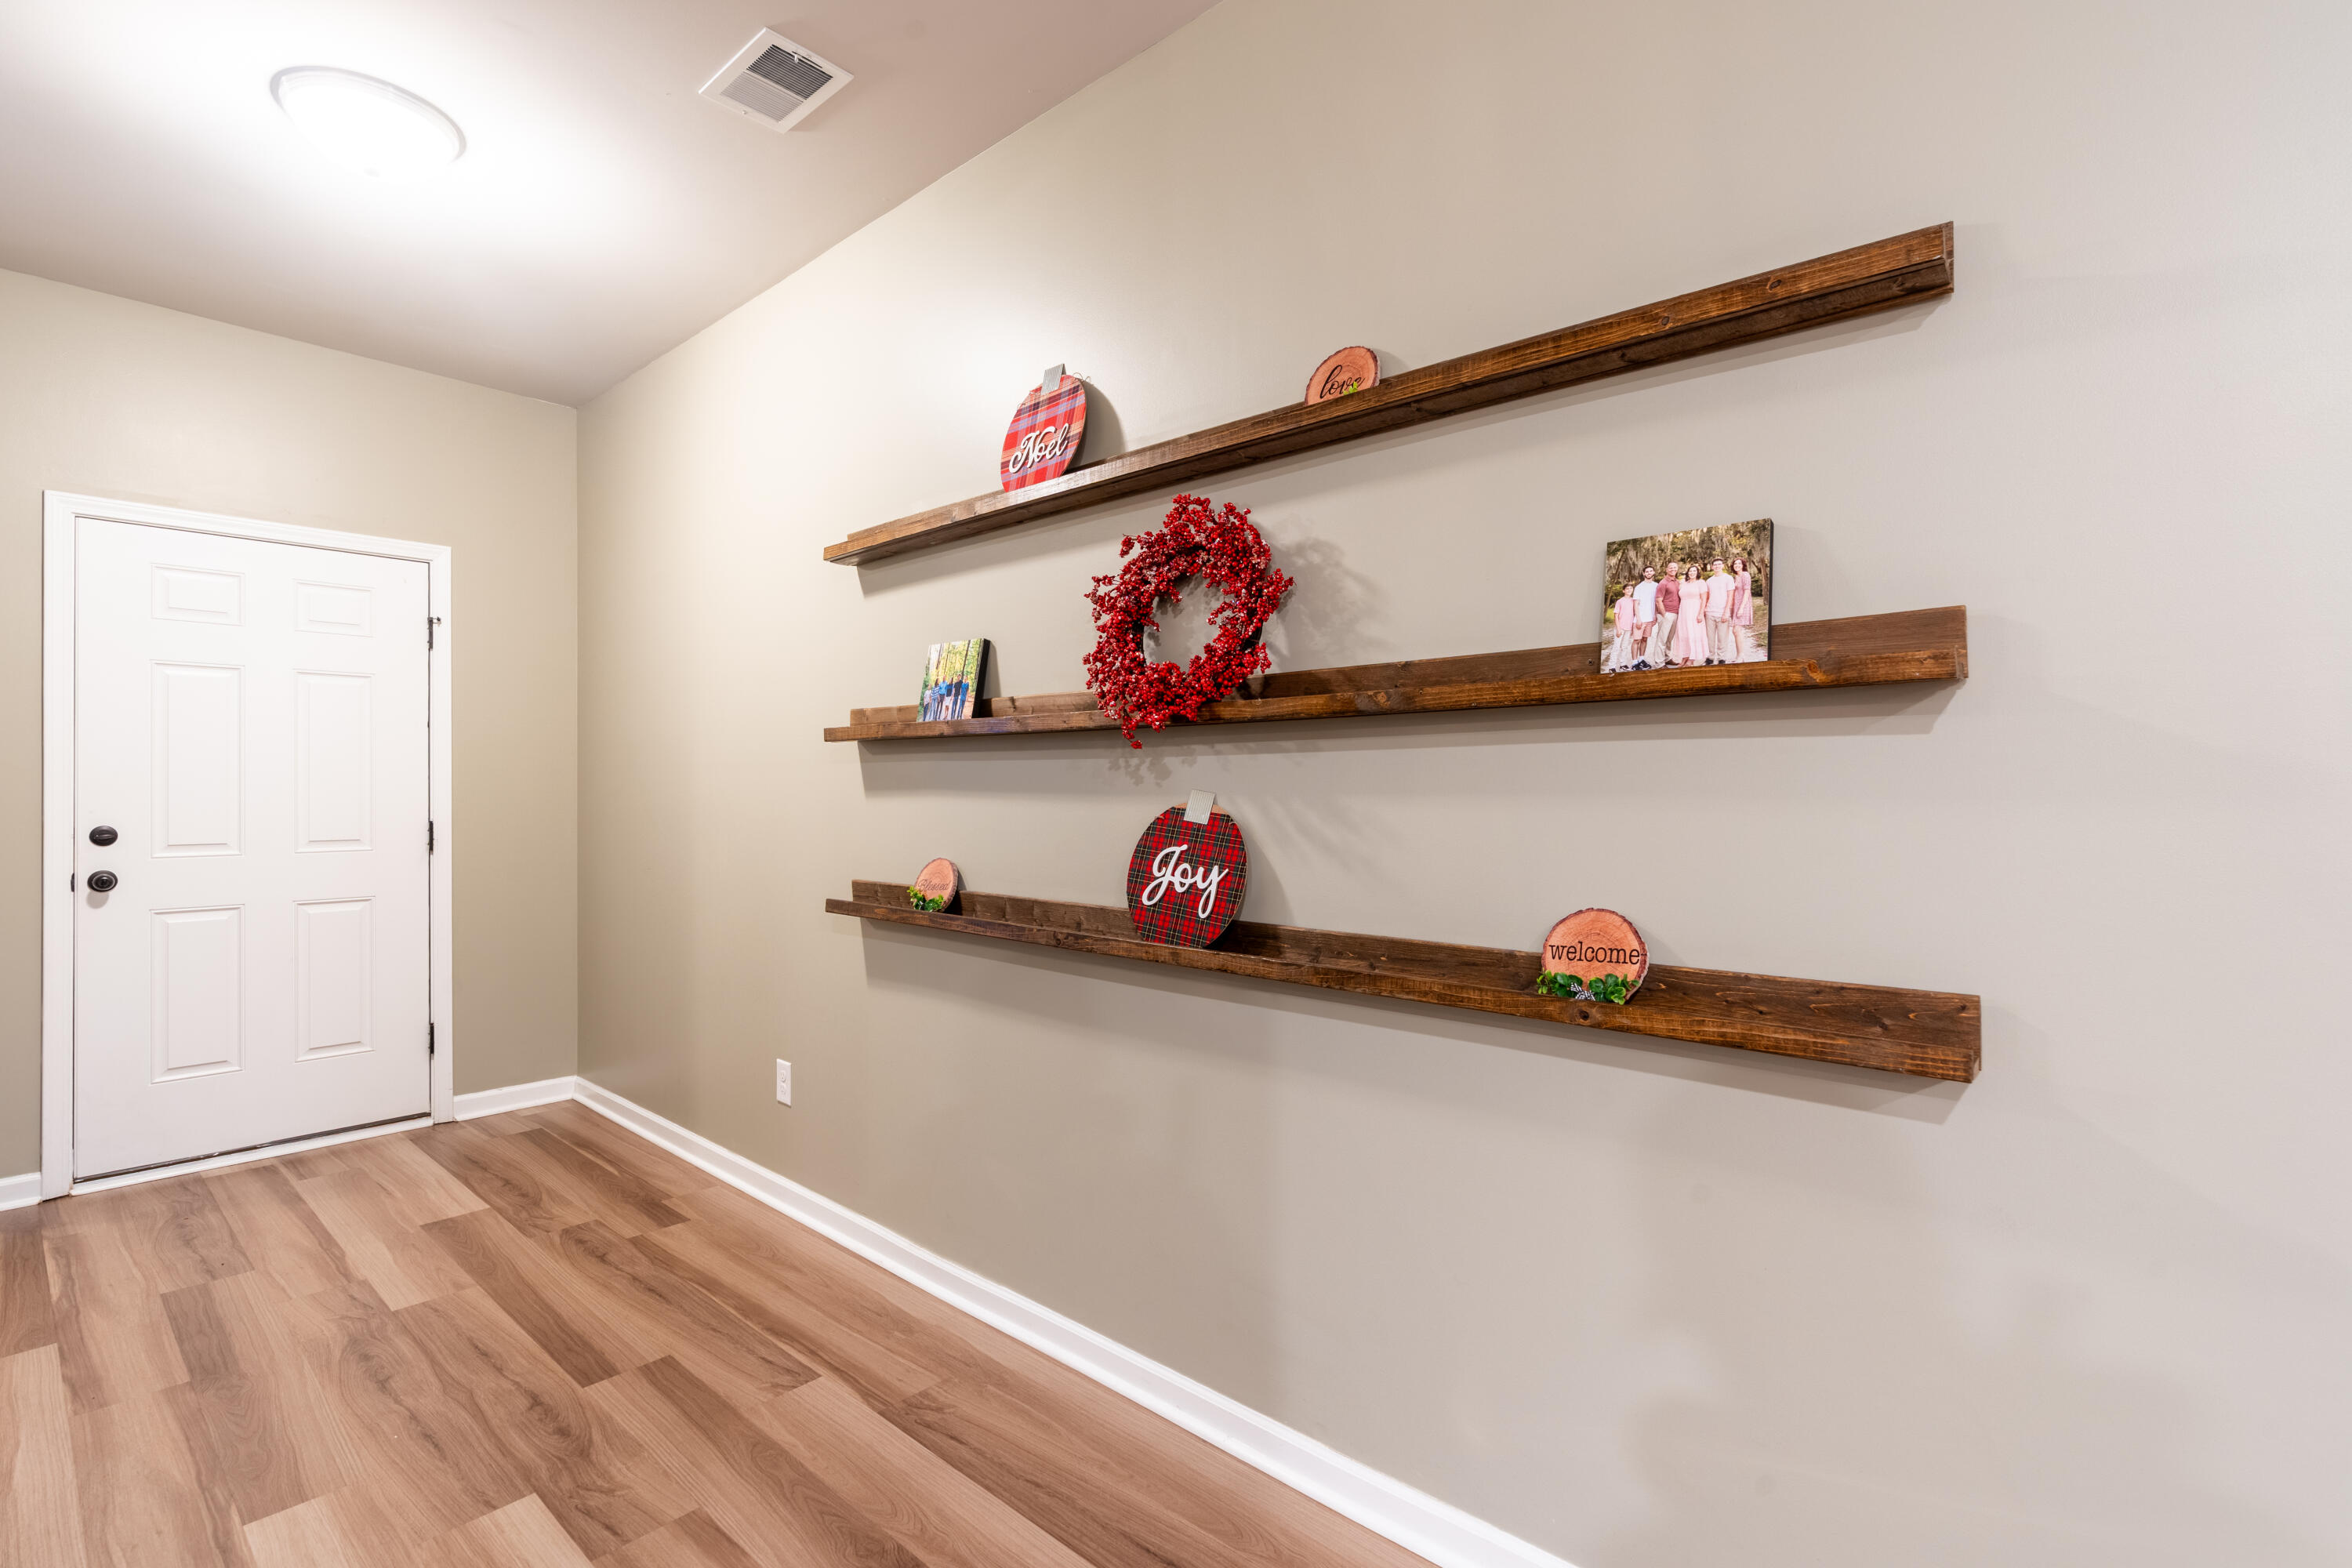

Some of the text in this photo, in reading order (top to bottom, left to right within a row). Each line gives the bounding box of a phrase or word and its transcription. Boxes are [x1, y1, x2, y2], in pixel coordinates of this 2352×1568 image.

[1319, 365, 1366, 399] love
[1008, 423, 1070, 474] Noel
[1142, 844, 1229, 919] Joy
[1548, 941, 1640, 965] welcome
